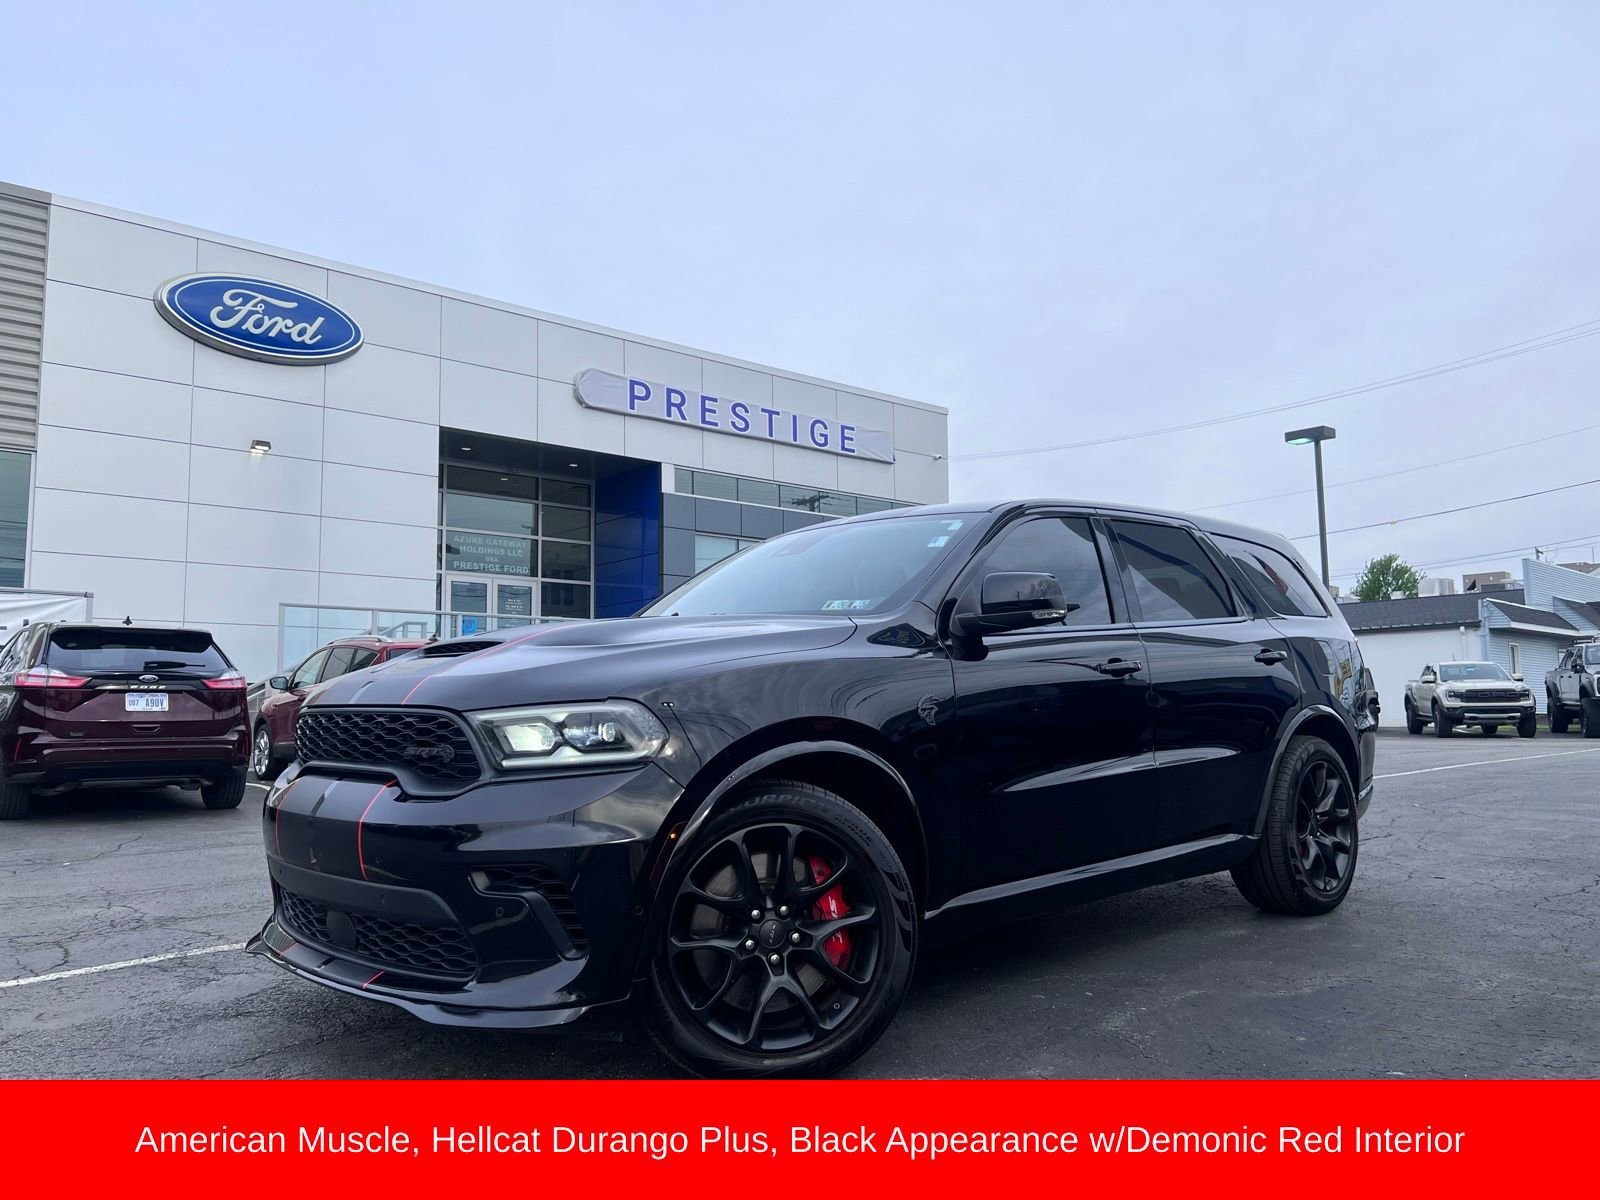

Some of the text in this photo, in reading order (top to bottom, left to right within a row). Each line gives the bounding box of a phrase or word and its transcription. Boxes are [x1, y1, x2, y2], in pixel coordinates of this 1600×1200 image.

[210, 288, 326, 345] Ford
[627, 378, 857, 454] PRESTIGE
[453, 535, 526, 548] AZURE GATEWAY
[460, 545, 524, 557] HOLDINGS LLC
[453, 561, 529, 574] PRESTIGE FORD
